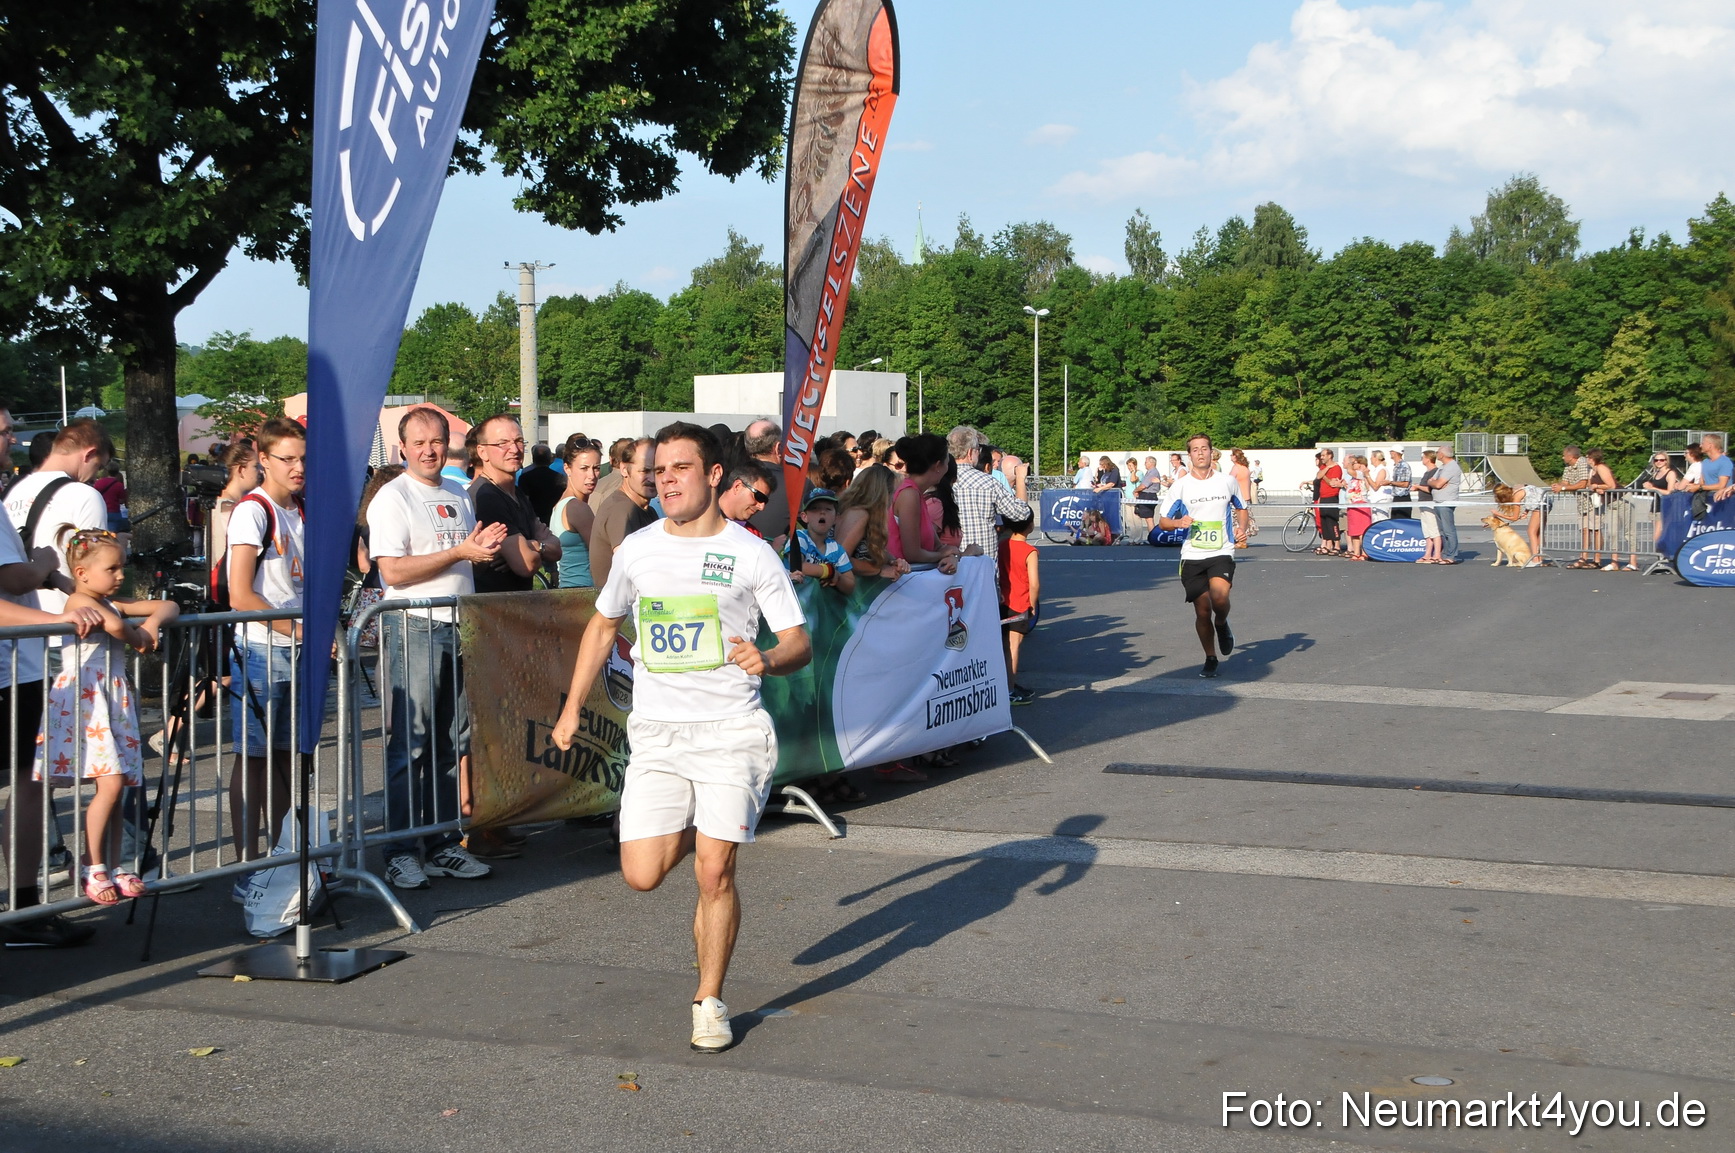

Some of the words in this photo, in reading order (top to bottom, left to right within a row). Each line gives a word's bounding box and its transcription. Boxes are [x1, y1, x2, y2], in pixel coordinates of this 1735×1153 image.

[415, 0, 461, 150] AUTO
[1190, 495, 1227, 504] DELPHI
[1195, 530, 1218, 542] 216
[703, 562, 735, 572] MICKAN
[650, 621, 705, 653] 867
[931, 658, 988, 692] Neumarkter
[925, 681, 997, 730] Lammsbräu
